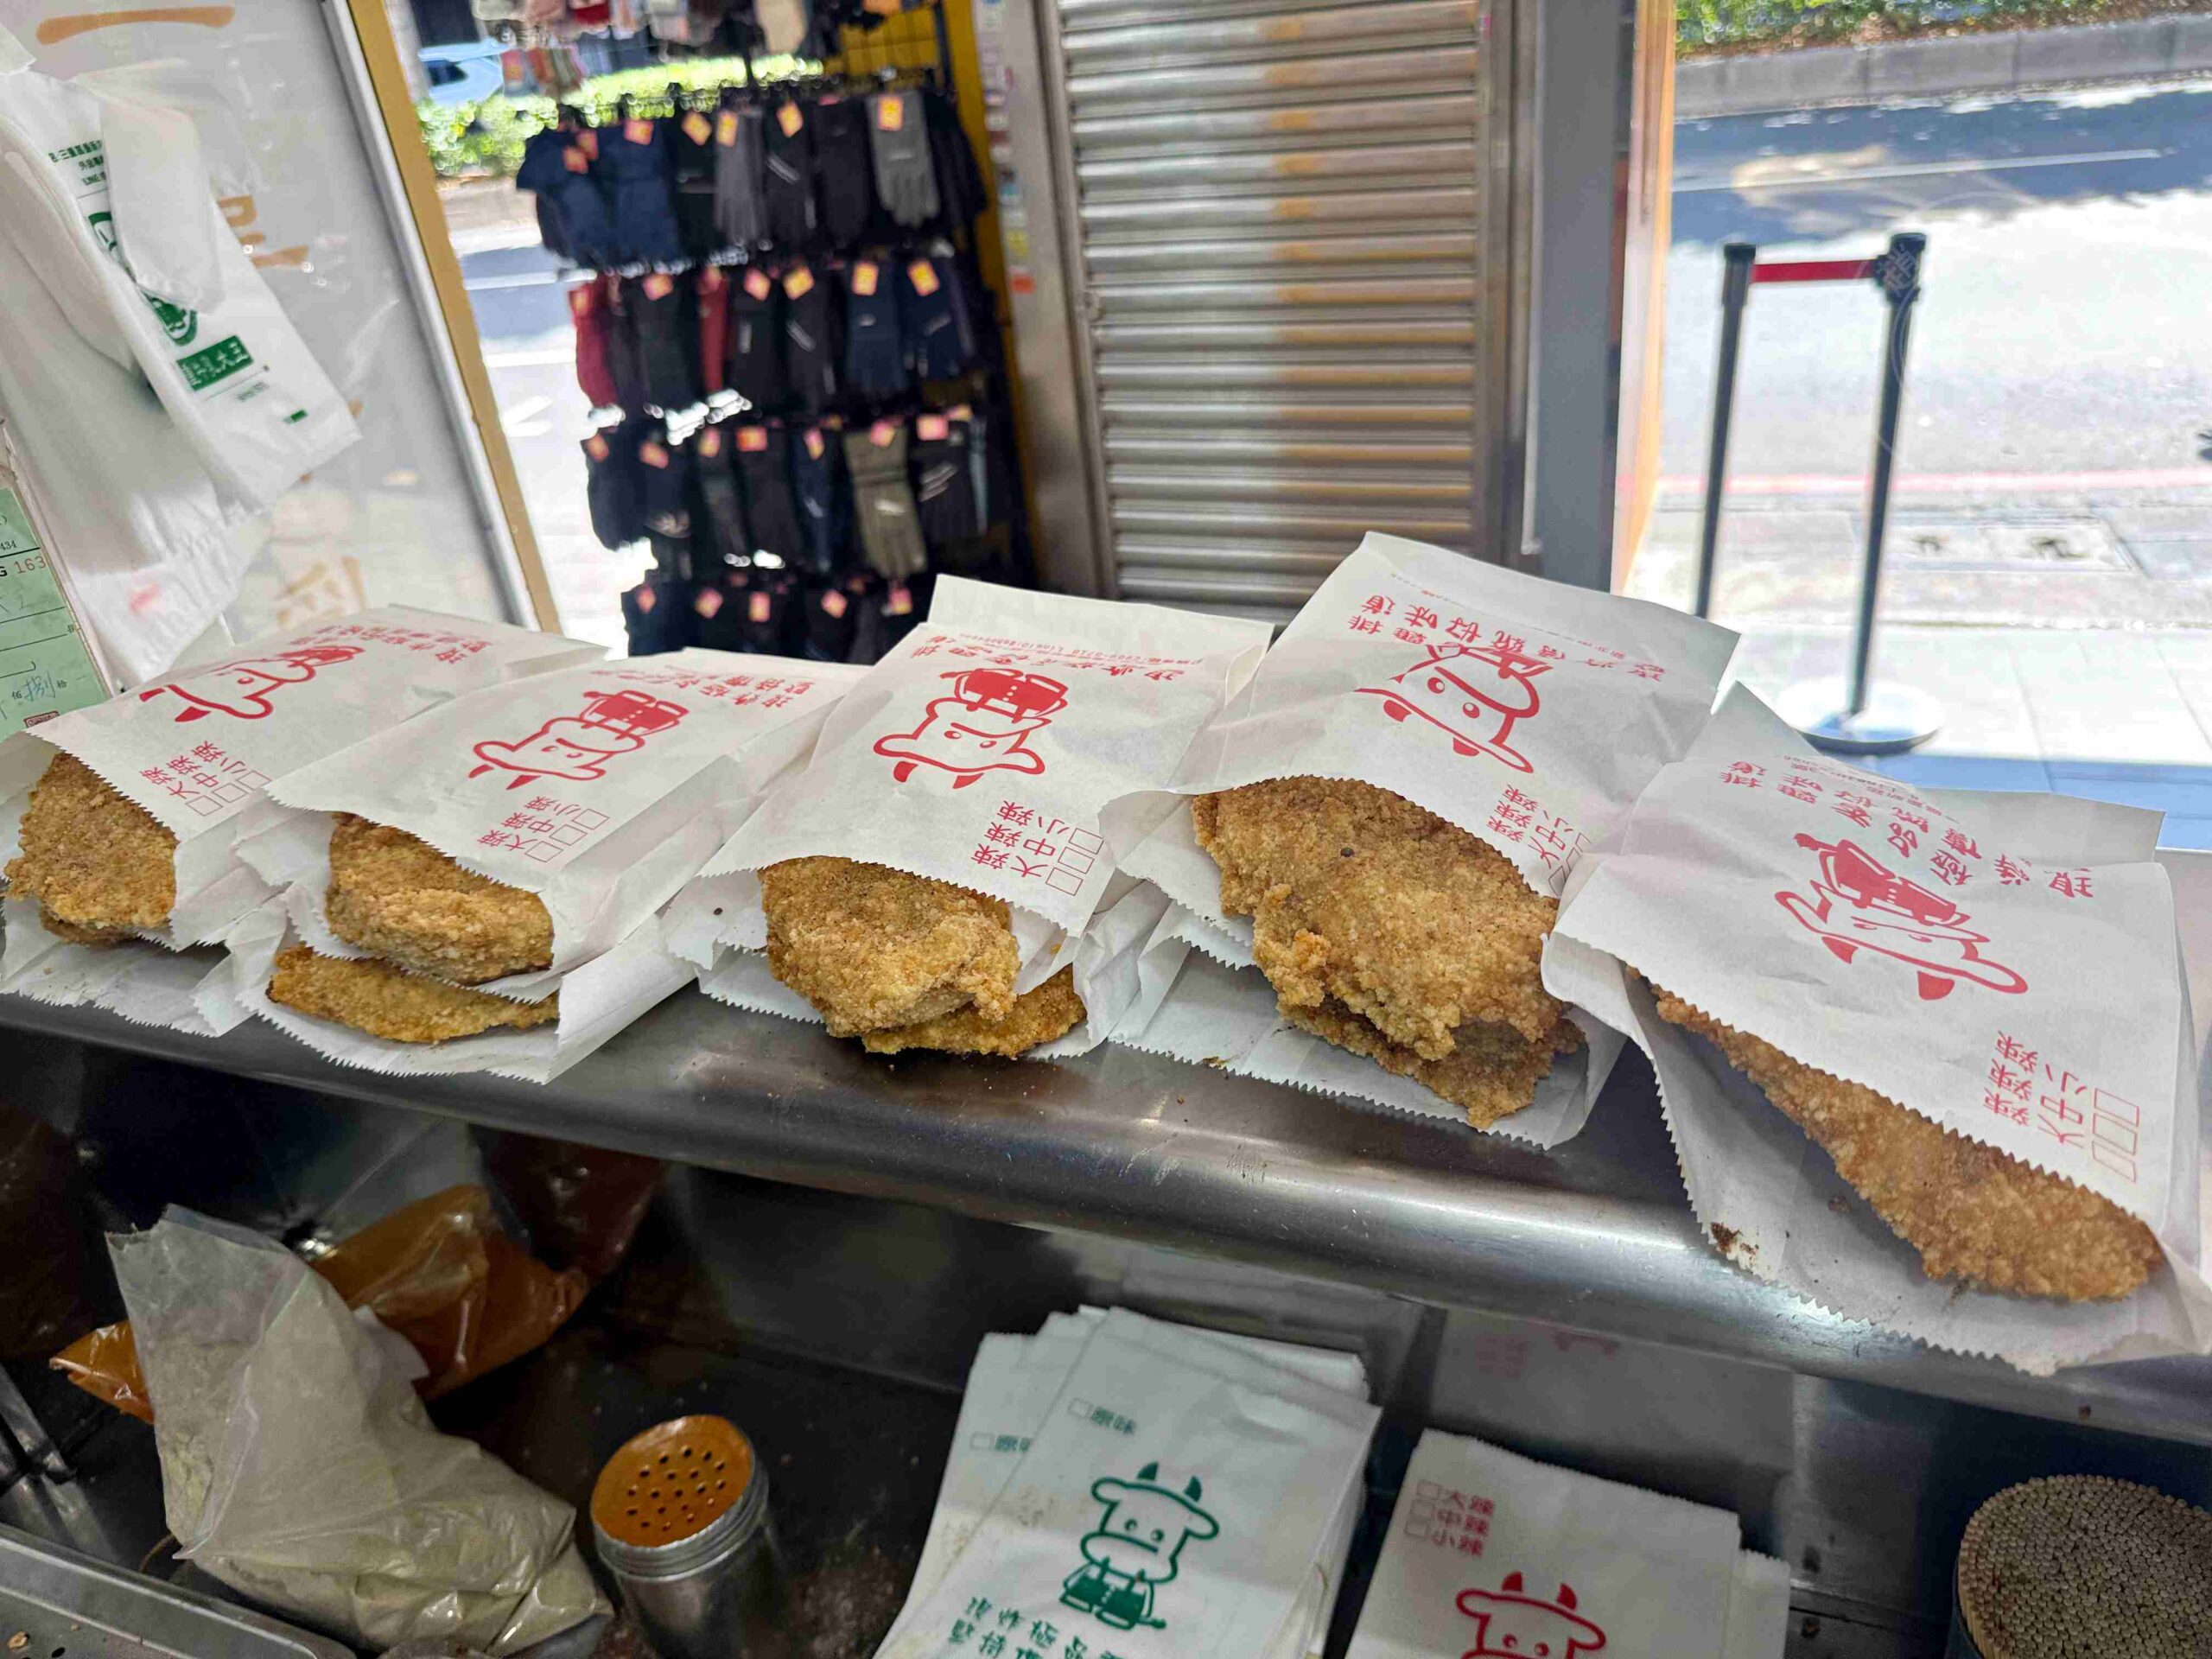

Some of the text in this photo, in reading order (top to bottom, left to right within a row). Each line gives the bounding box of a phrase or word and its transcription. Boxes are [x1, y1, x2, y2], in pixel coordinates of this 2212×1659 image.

[14, 556, 47, 574] 163
[165, 755, 219, 788] 中辣
[191, 741, 247, 773] 小辣
[139, 766, 200, 799] 大辣
[501, 811, 555, 834] 中辣
[524, 796, 582, 817] 小辣
[997, 800, 1071, 835] 小辣
[1503, 784, 1574, 832] 小辣
[477, 830, 538, 851] 大辣
[984, 822, 1057, 856] 中辣
[1494, 800, 1566, 851] 中辣
[1486, 816, 1560, 870] 大辣
[970, 843, 1049, 878] 大辣
[1995, 1030, 2088, 1093] 小辣
[1987, 1058, 2084, 1125] 中辣
[1983, 1087, 2084, 1149] 大辣
